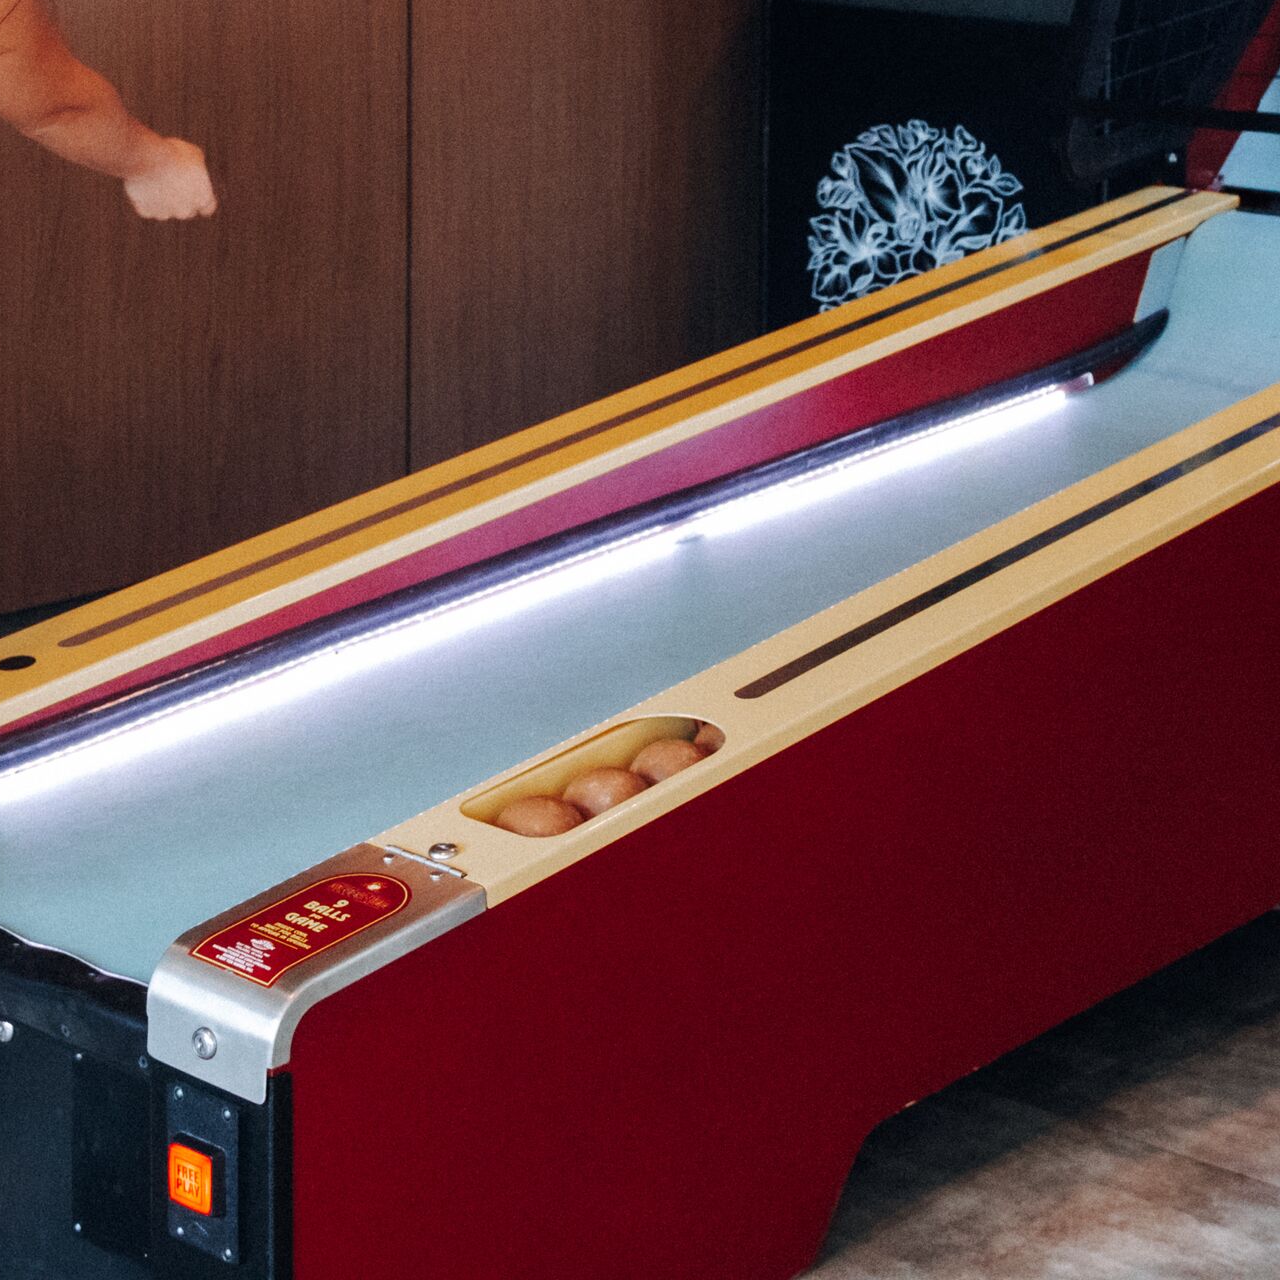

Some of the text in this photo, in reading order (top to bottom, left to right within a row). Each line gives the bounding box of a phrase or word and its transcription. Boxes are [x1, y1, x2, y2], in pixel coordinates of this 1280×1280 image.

[303, 900, 351, 922] BALLS
[332, 899, 349, 908] 9
[284, 912, 328, 933] GAME
[176, 1164, 199, 1184] FREE
[176, 1178, 200, 1198] PLAY
